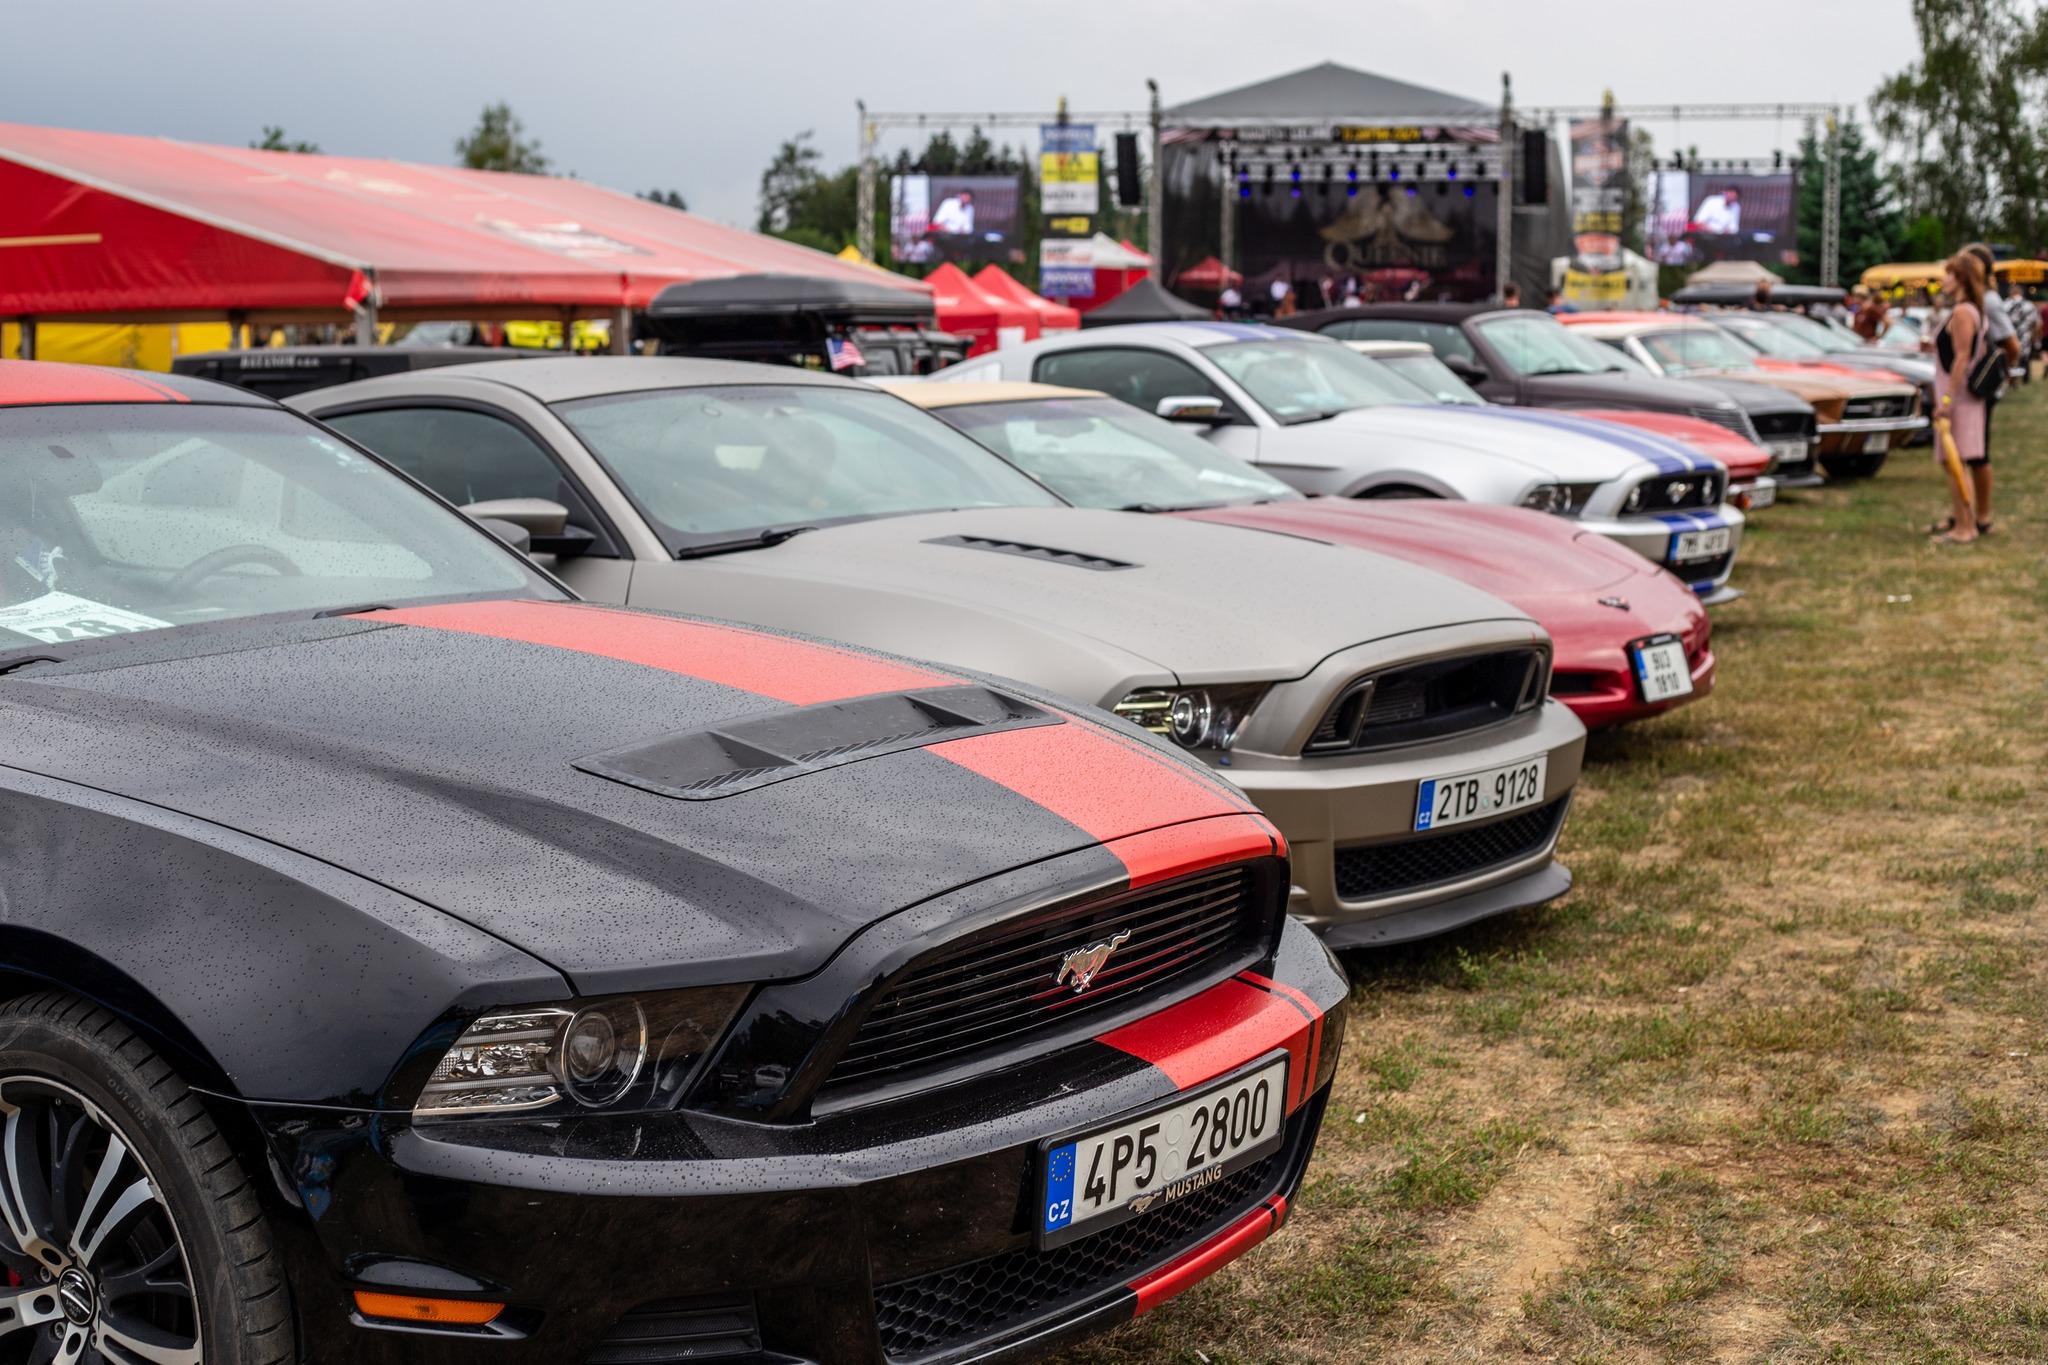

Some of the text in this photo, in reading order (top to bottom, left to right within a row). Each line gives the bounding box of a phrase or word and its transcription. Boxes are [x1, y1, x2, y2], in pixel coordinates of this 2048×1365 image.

[1437, 764, 1538, 821] 2TB 9128
[1418, 811, 1431, 825] CZ
[1083, 1078, 1269, 1208] 4P5 2800
[1164, 1164, 1223, 1203] MUSTANG
[1048, 1198, 1070, 1223] CZ
